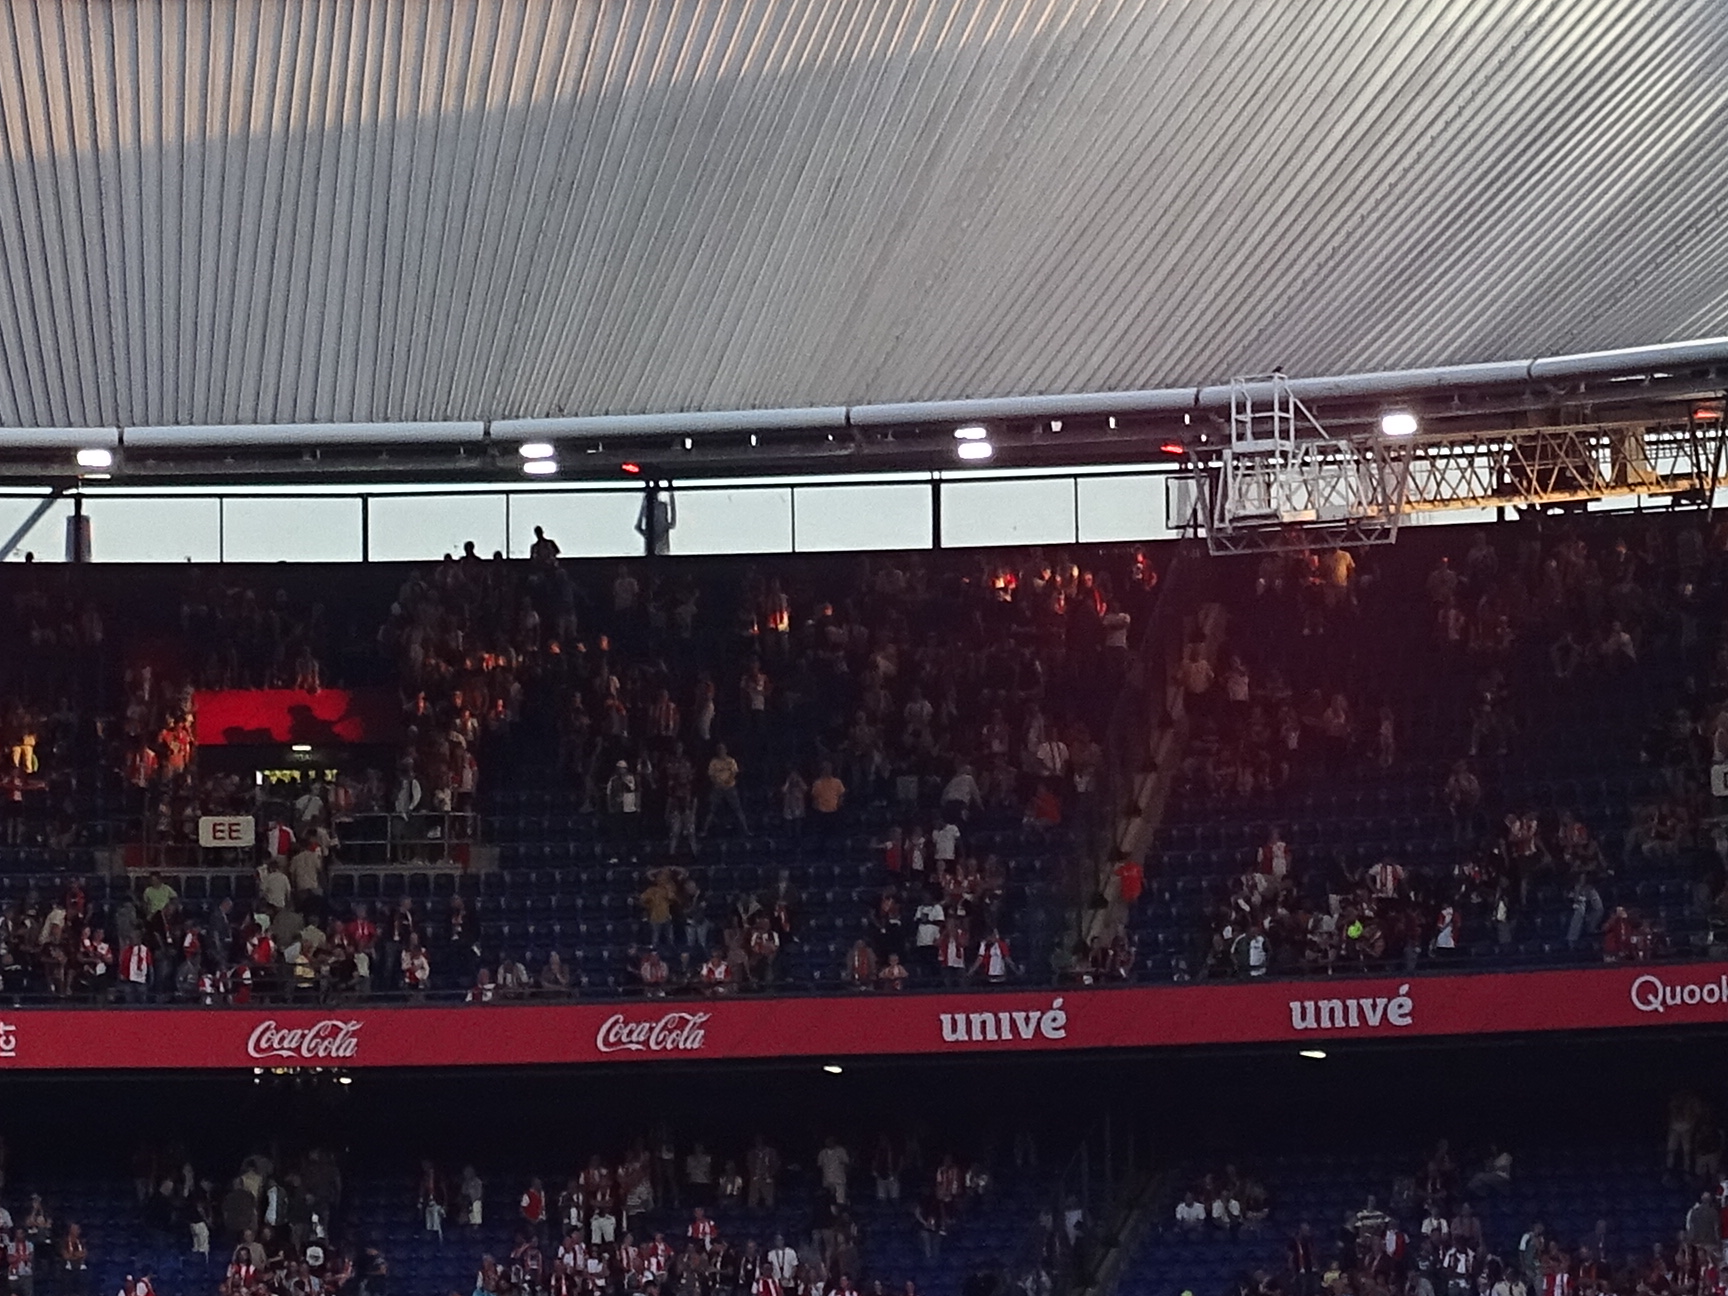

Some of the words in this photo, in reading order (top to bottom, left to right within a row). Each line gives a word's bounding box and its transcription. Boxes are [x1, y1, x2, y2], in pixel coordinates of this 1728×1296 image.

[211, 822, 242, 841] EE
[939, 997, 1067, 1042] univé
[1289, 983, 1413, 1030] univé
[247, 1020, 363, 1058] Coca-Cola
[596, 1012, 711, 1052] Coca-Cola
